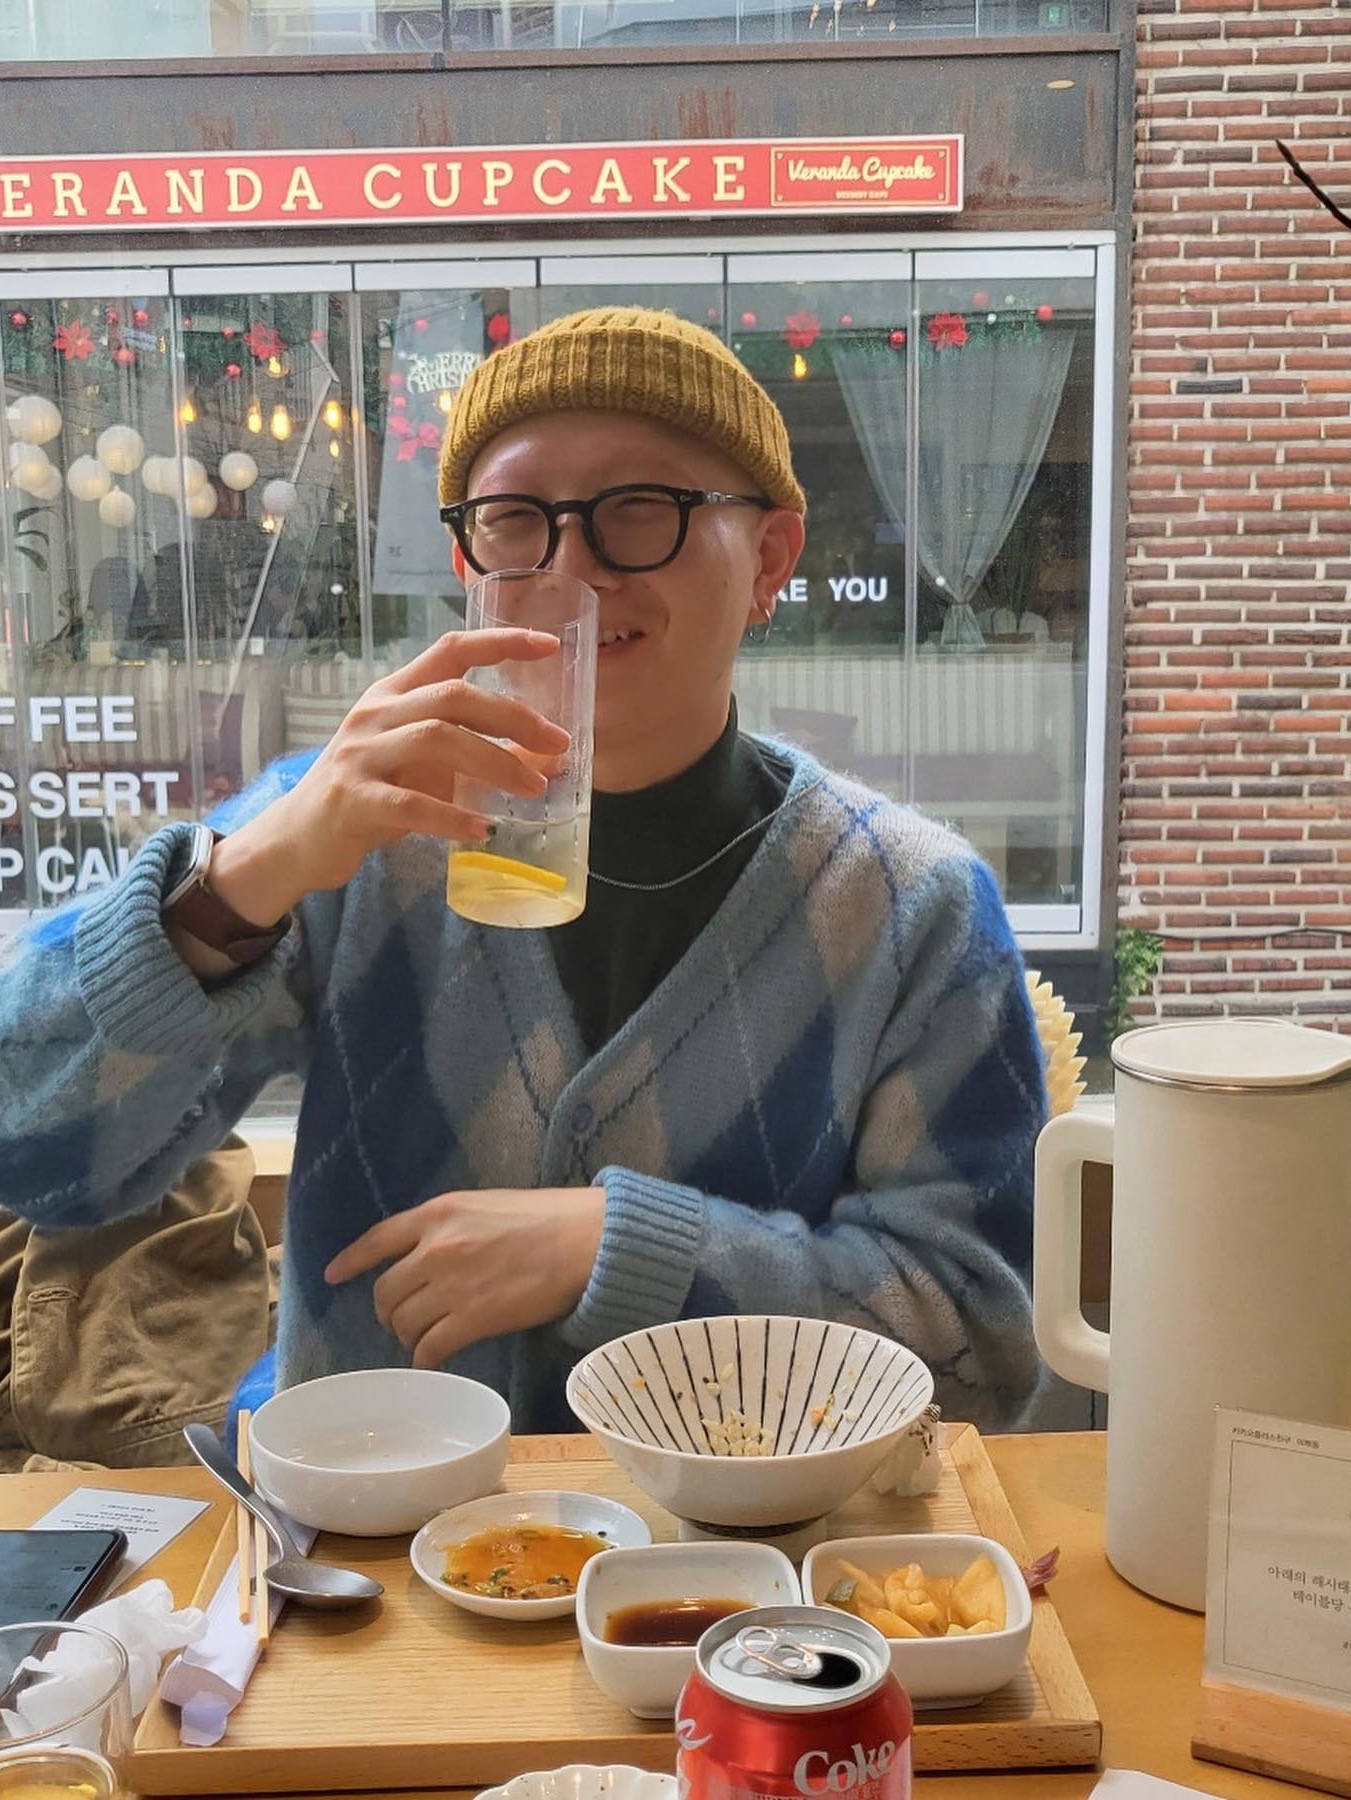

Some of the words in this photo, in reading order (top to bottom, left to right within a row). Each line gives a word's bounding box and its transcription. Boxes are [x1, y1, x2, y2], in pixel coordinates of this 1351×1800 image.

[0, 166, 323, 218] ERANDA
[363, 156, 745, 209] CUPCAKE
[788, 155, 861, 181] Veranda
[862, 155, 936, 189] Cupcake
[828, 578, 887, 602] YOU
[1268, 1566, 1306, 1585] 아래의
[1312, 1575, 1351, 1595] 해시태
[1292, 1590, 1344, 1612] 테이블당
[793, 1740, 896, 1796] Coke
